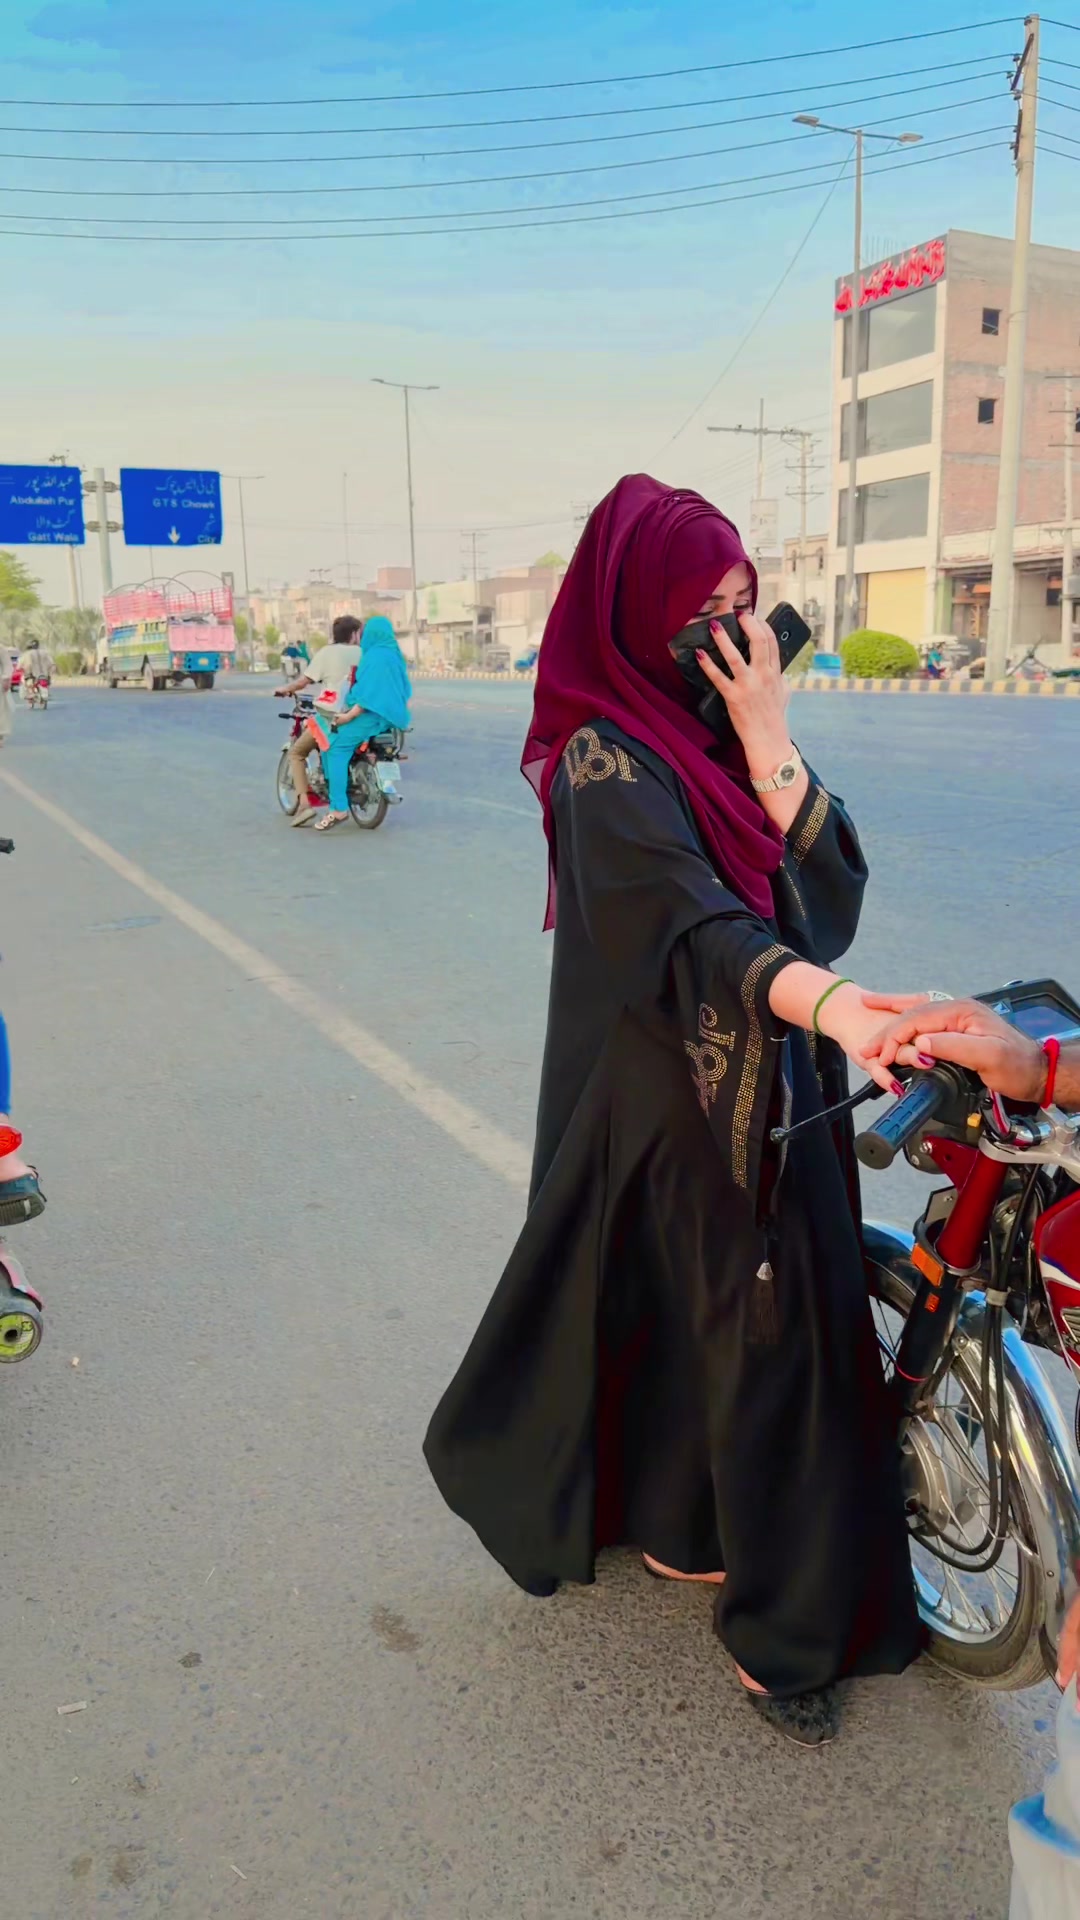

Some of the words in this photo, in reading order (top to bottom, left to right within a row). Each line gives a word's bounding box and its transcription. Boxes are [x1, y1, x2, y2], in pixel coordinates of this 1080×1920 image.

[9, 495, 56, 505] Abdullah
[58, 496, 76, 506] Pur
[181, 499, 215, 509] Chowk
[53, 532, 79, 542] Wala
[197, 534, 216, 544] City
